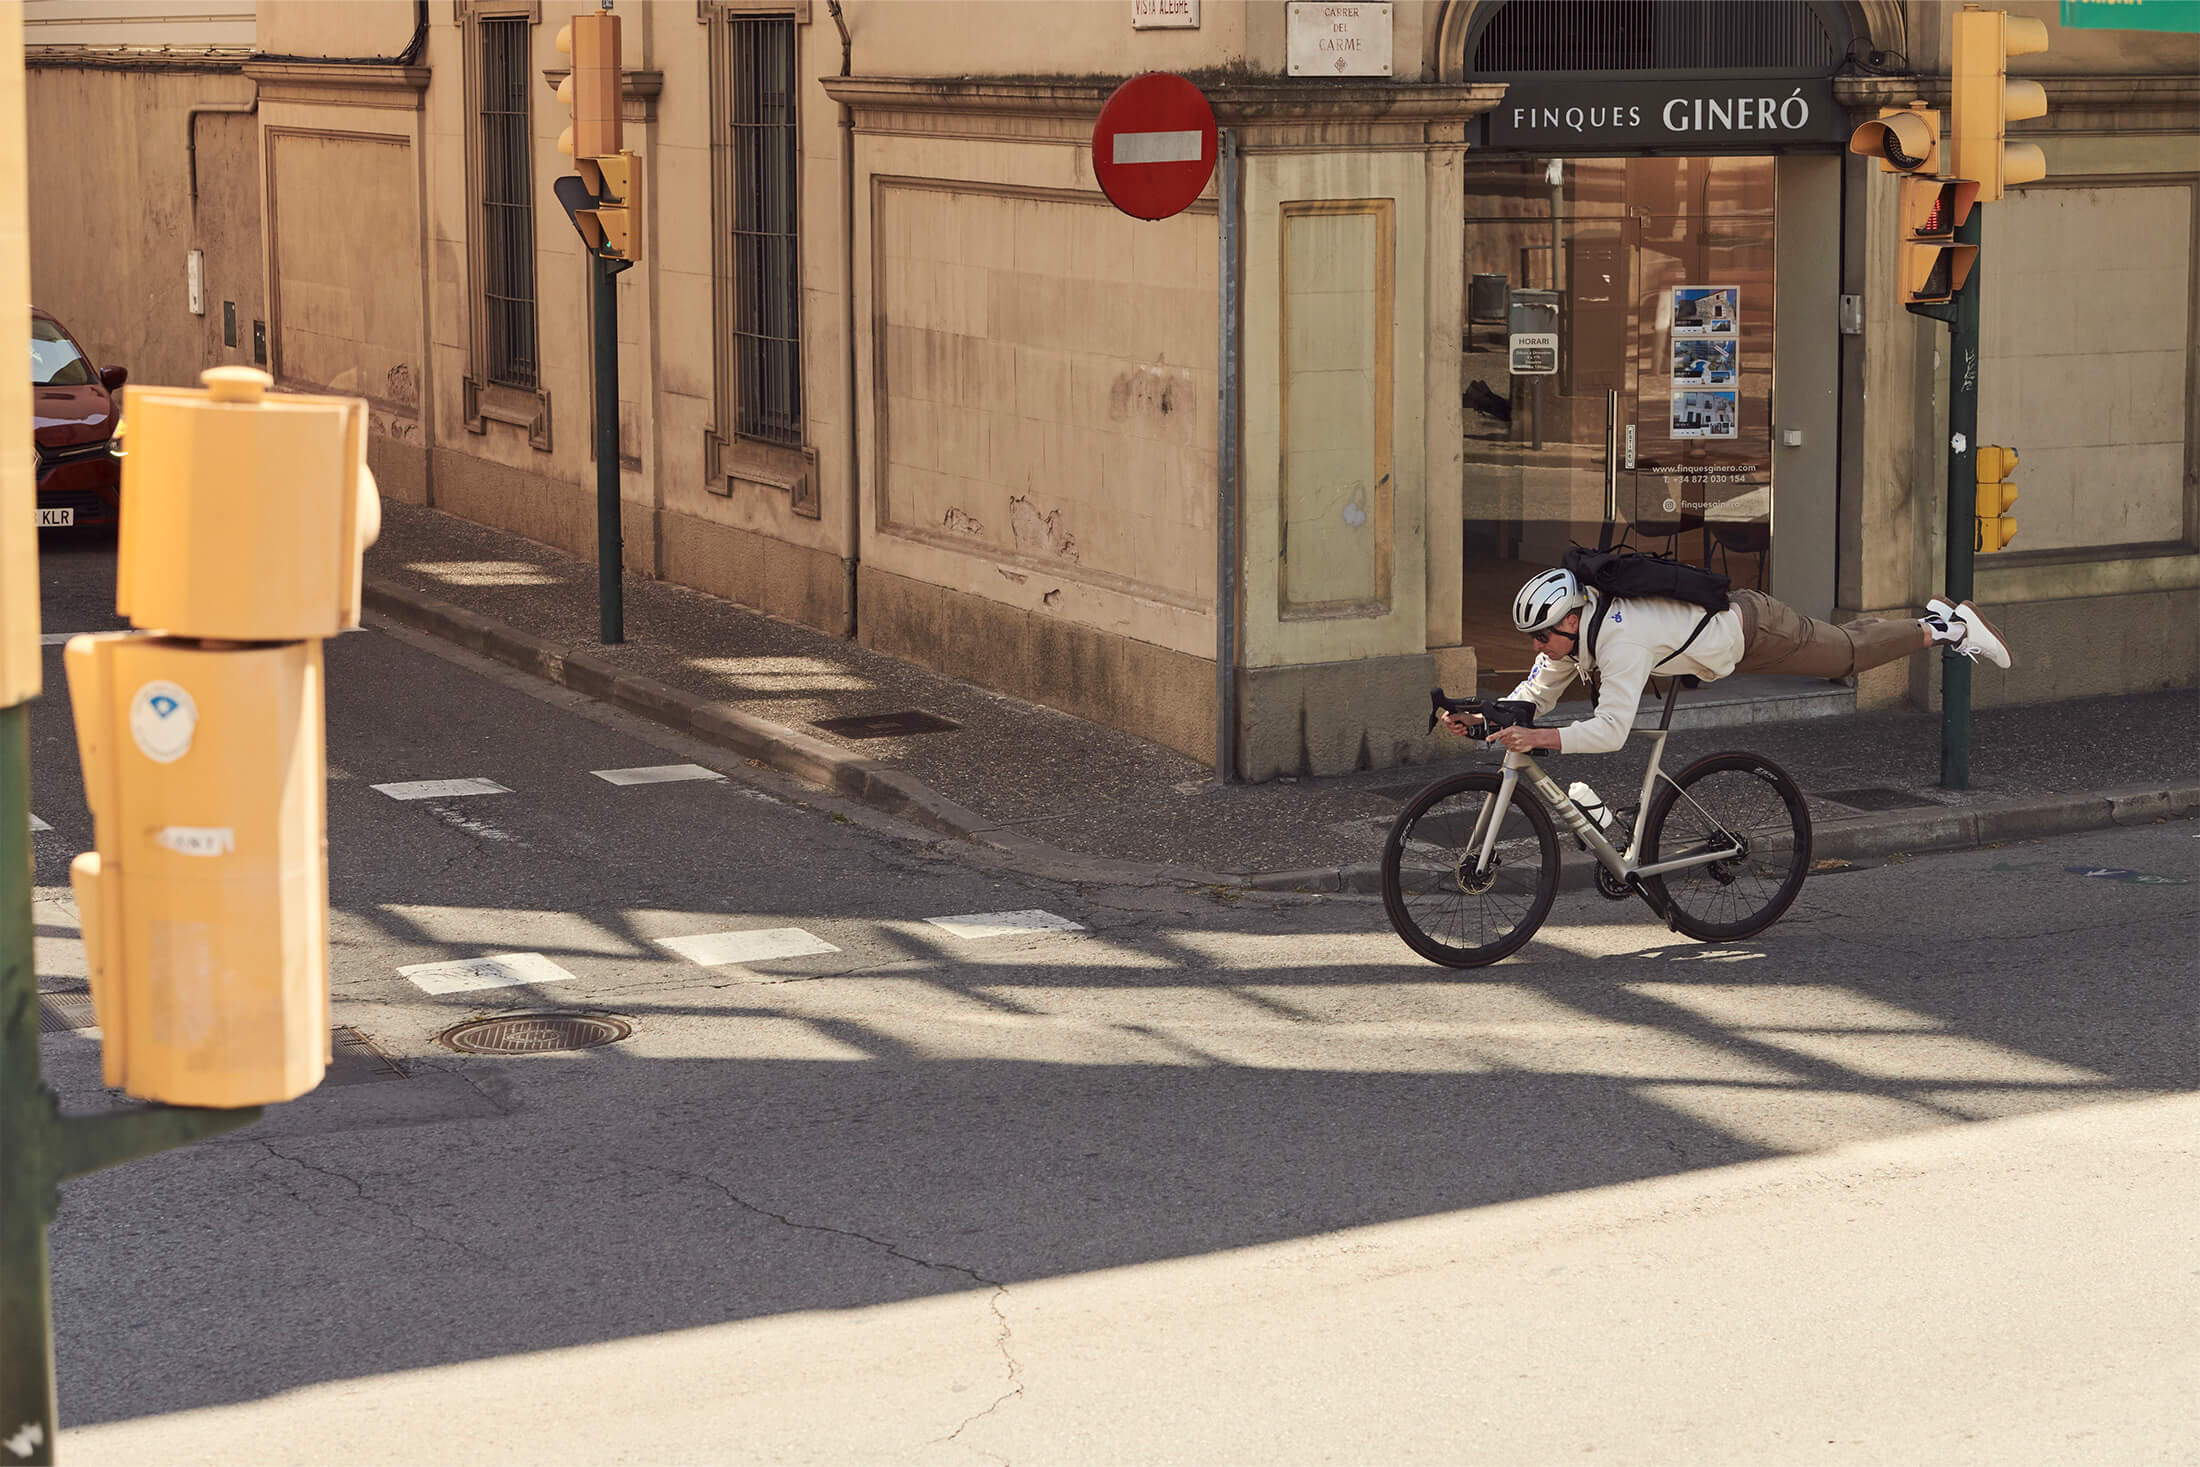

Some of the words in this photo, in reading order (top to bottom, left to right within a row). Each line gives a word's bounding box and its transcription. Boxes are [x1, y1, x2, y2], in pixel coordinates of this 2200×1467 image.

[1324, 7, 1359, 17] CARRER
[1333, 23, 1348, 33] DEL
[1319, 38, 1361, 51] CARME
[1513, 106, 1641, 132] FINQUES
[1662, 88, 1809, 132] GINERÓ
[1652, 463, 1756, 474] www.finquesginero.com
[1692, 475, 1708, 483] 872
[1711, 475, 1727, 483] 030
[1730, 474, 1746, 482] 154
[42, 510, 70, 525] KLR
